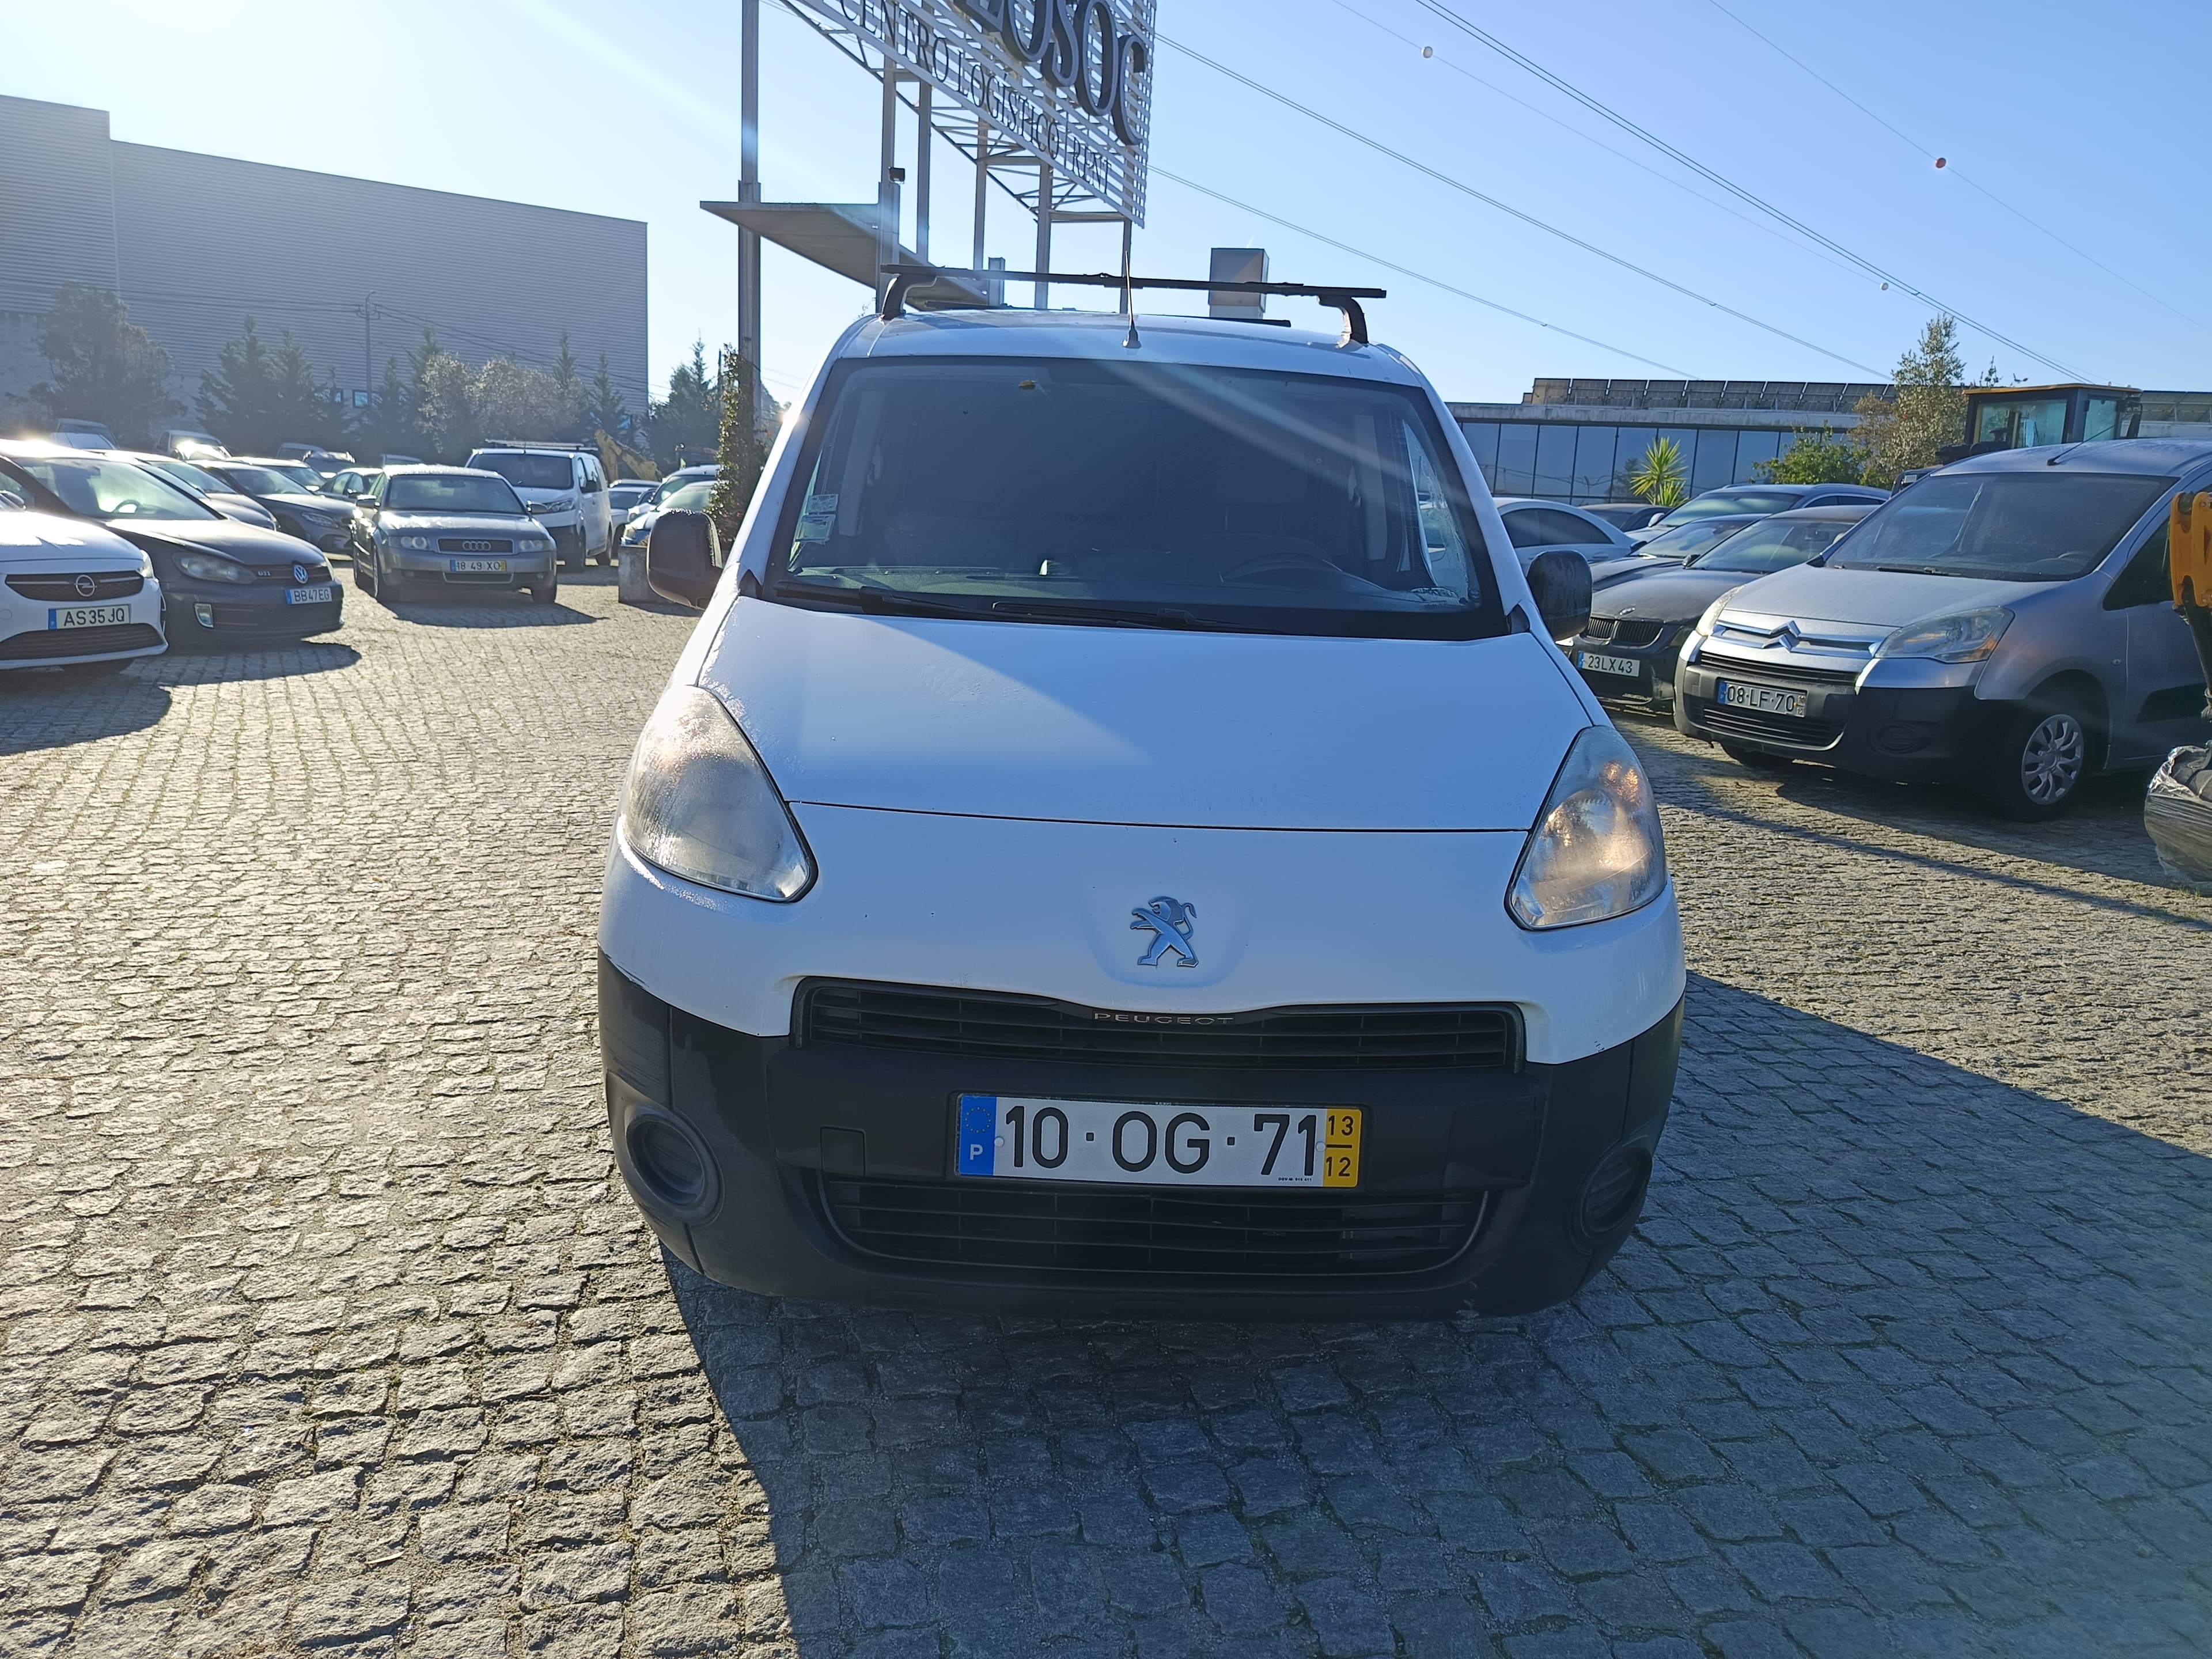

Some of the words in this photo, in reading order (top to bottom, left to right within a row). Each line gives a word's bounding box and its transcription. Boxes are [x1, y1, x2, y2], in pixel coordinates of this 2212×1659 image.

[1094, 1013, 1234, 1025] PEUGEOT
[1328, 1115, 1354, 1136] 13
[969, 1144, 983, 1160] P
[1326, 1157, 1351, 1177] 12
